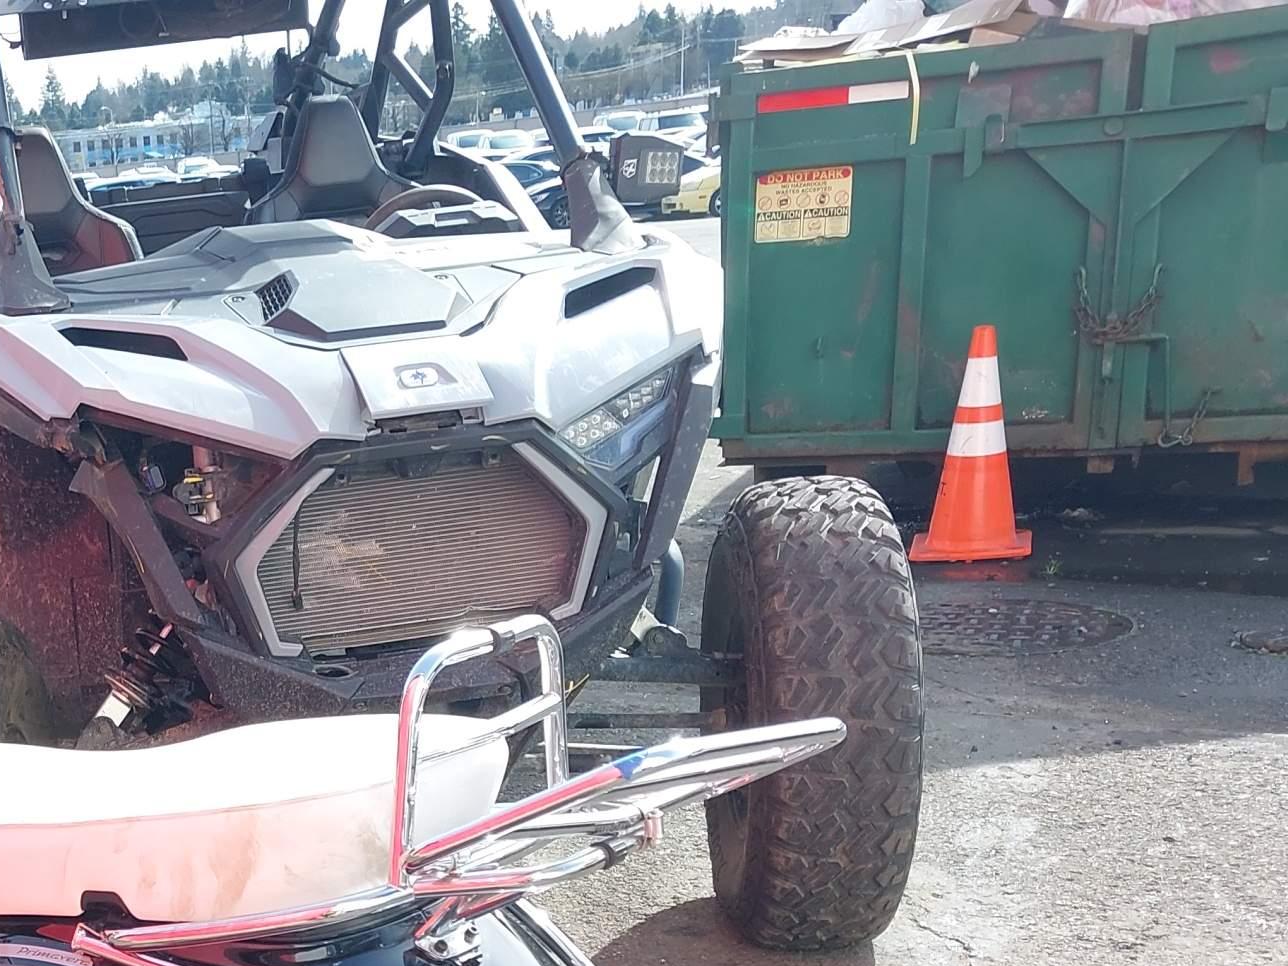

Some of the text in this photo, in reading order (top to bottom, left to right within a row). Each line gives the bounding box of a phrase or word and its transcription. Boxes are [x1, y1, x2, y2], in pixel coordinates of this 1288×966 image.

[767, 169, 844, 184] DO NOT PARK
[765, 210, 801, 220] CAUTION
[812, 207, 848, 217] CAUTION
